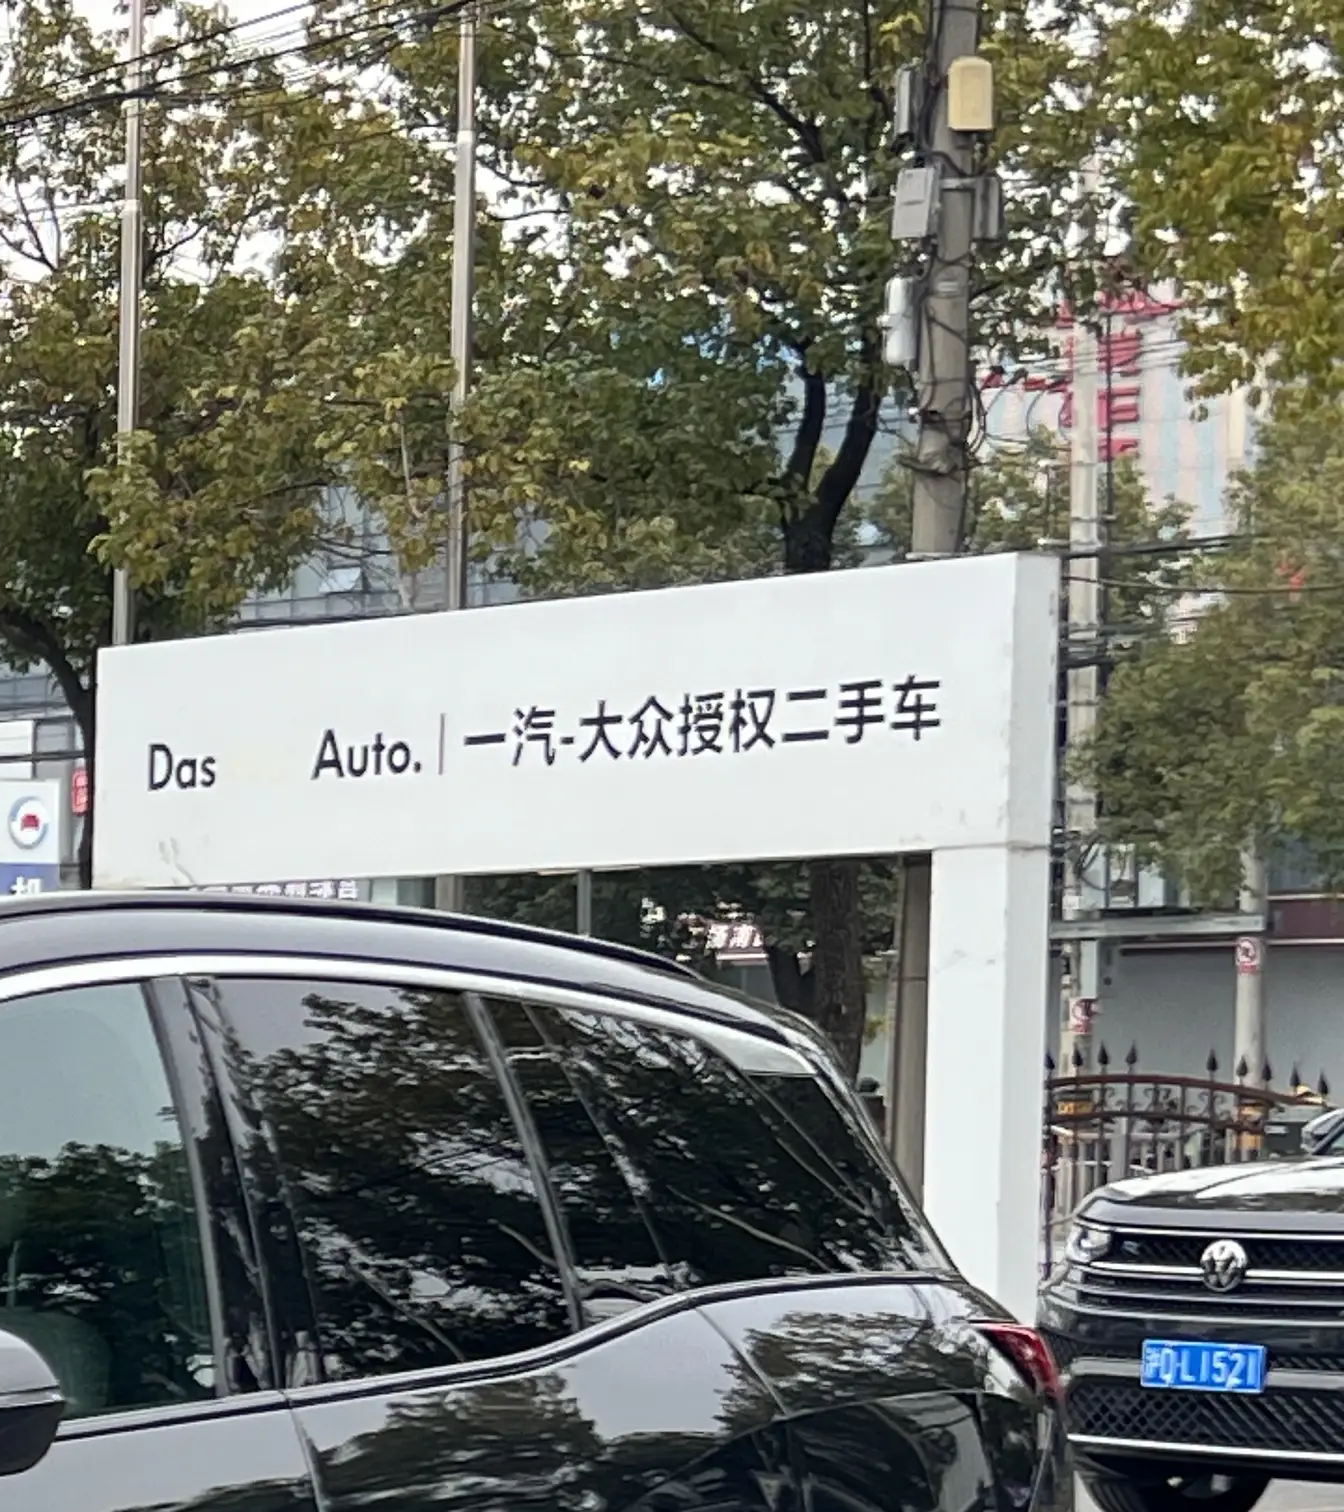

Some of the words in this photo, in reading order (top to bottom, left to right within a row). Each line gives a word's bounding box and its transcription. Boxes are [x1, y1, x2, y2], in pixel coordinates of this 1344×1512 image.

[148, 743, 217, 790] Das
[313, 728, 422, 779] Auto.
[462, 674, 942, 769] 一汽-大众授权二手车
